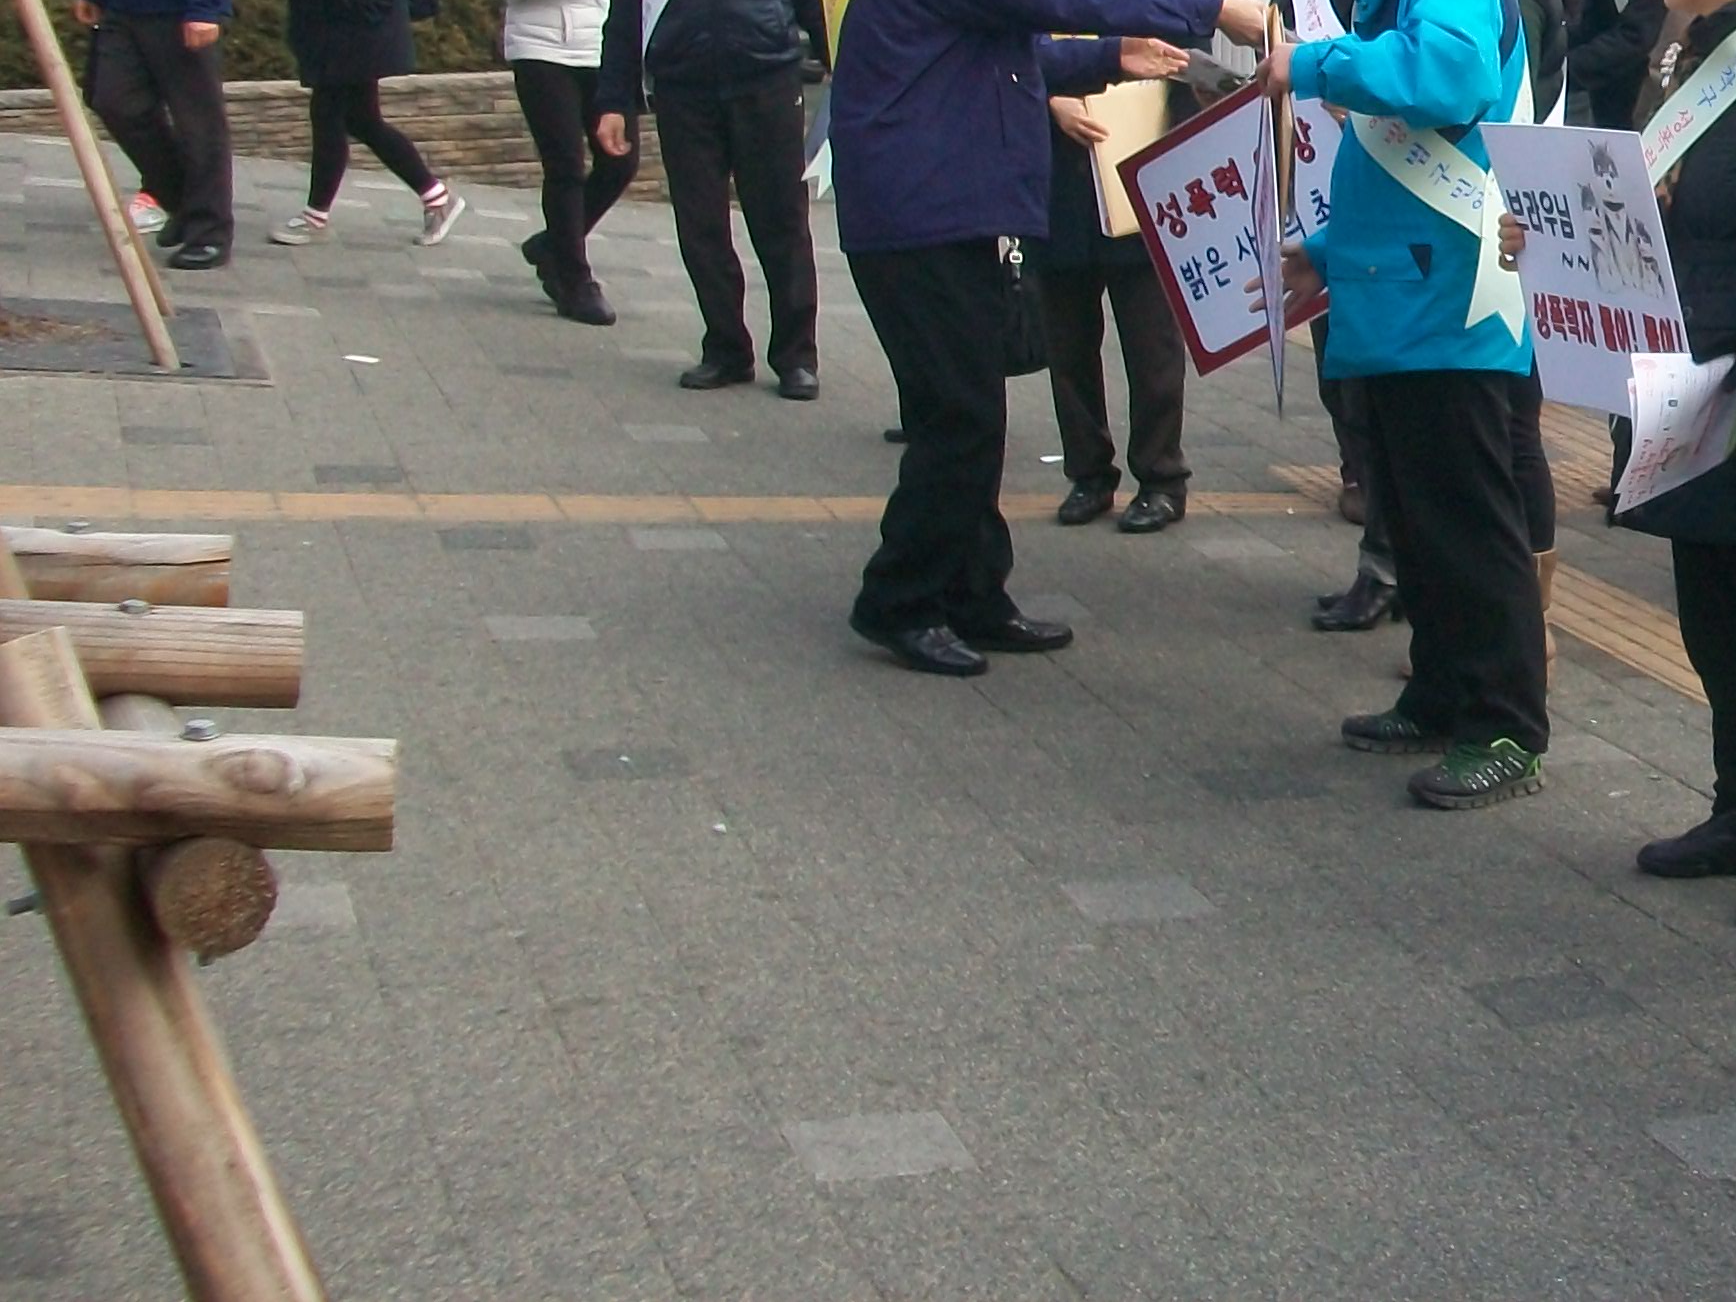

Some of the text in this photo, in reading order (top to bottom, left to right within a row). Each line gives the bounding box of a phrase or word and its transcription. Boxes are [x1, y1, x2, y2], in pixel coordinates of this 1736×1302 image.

[1155, 157, 1249, 239] 성폭력
[1179, 245, 1232, 301] 밝은
[1532, 291, 1598, 348] 성폭력자
